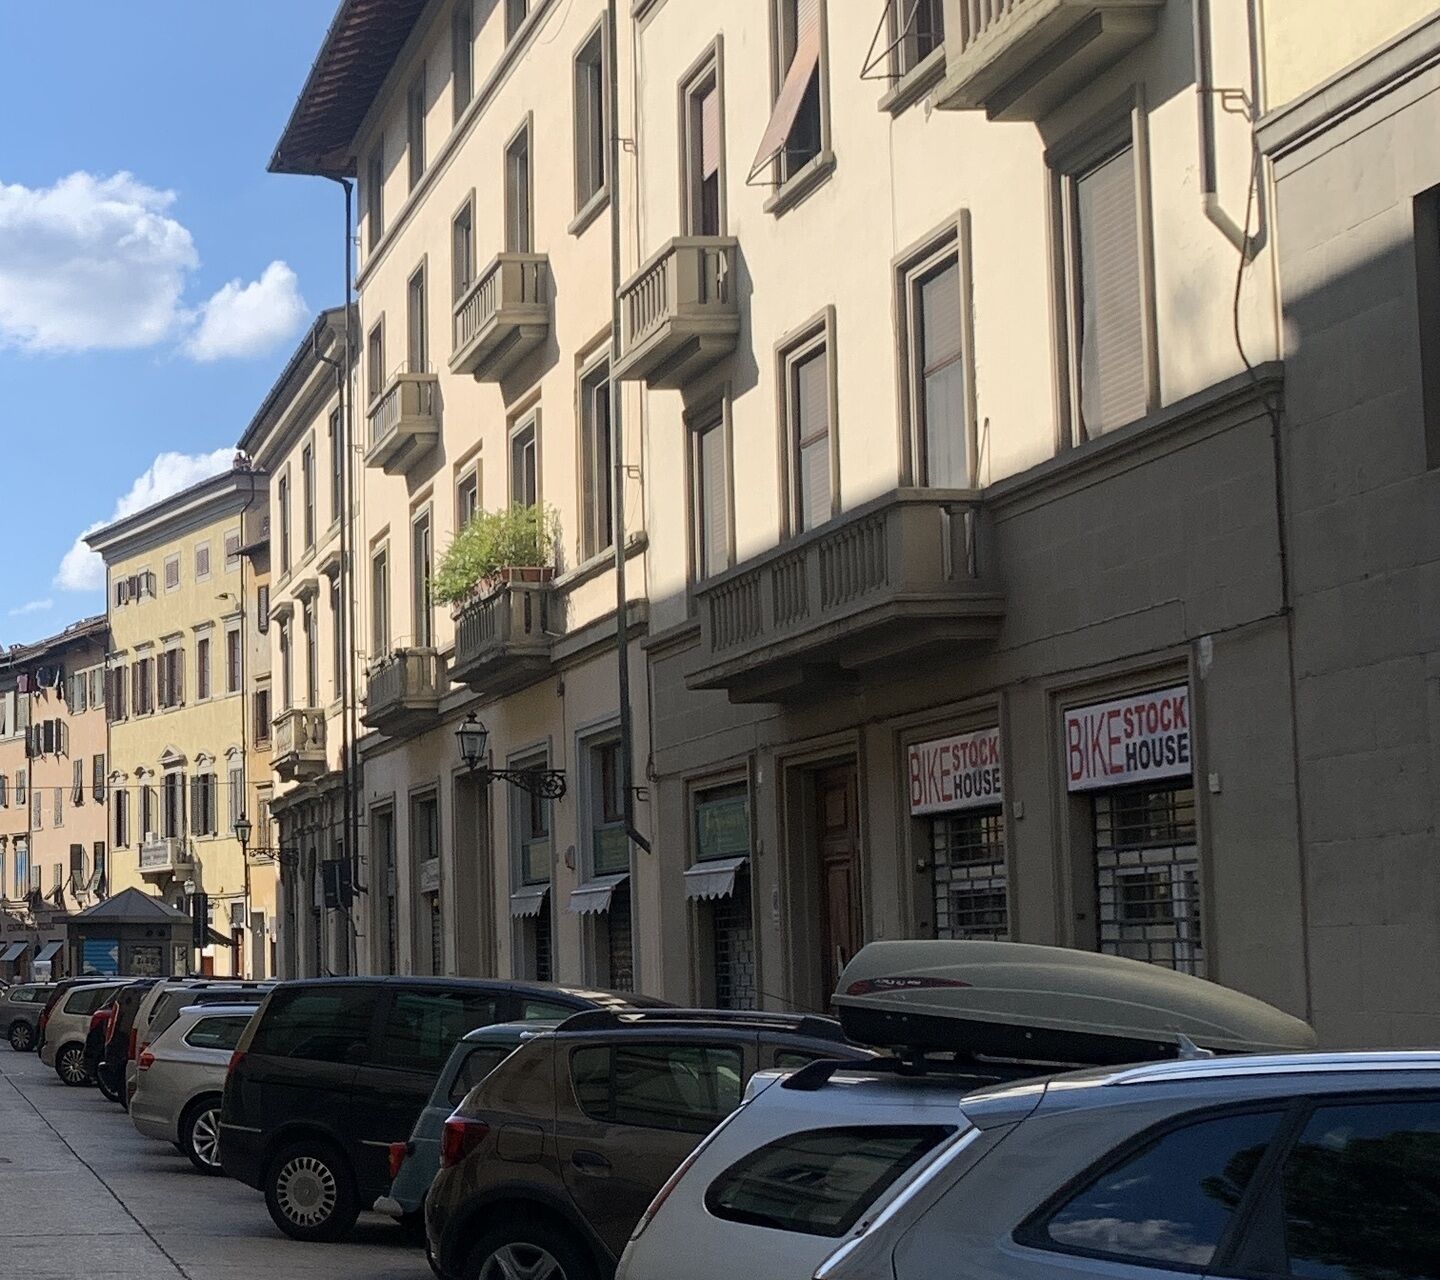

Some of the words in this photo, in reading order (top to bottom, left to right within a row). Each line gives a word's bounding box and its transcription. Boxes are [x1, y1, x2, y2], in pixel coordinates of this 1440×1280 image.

[1124, 696, 1187, 738] STOCK
[952, 735, 999, 769] STOCK
[1068, 710, 1124, 780] BIKE
[1126, 733, 1189, 771] HOUSE
[911, 746, 951, 806] BIKE
[954, 768, 1000, 799] HOUSE
